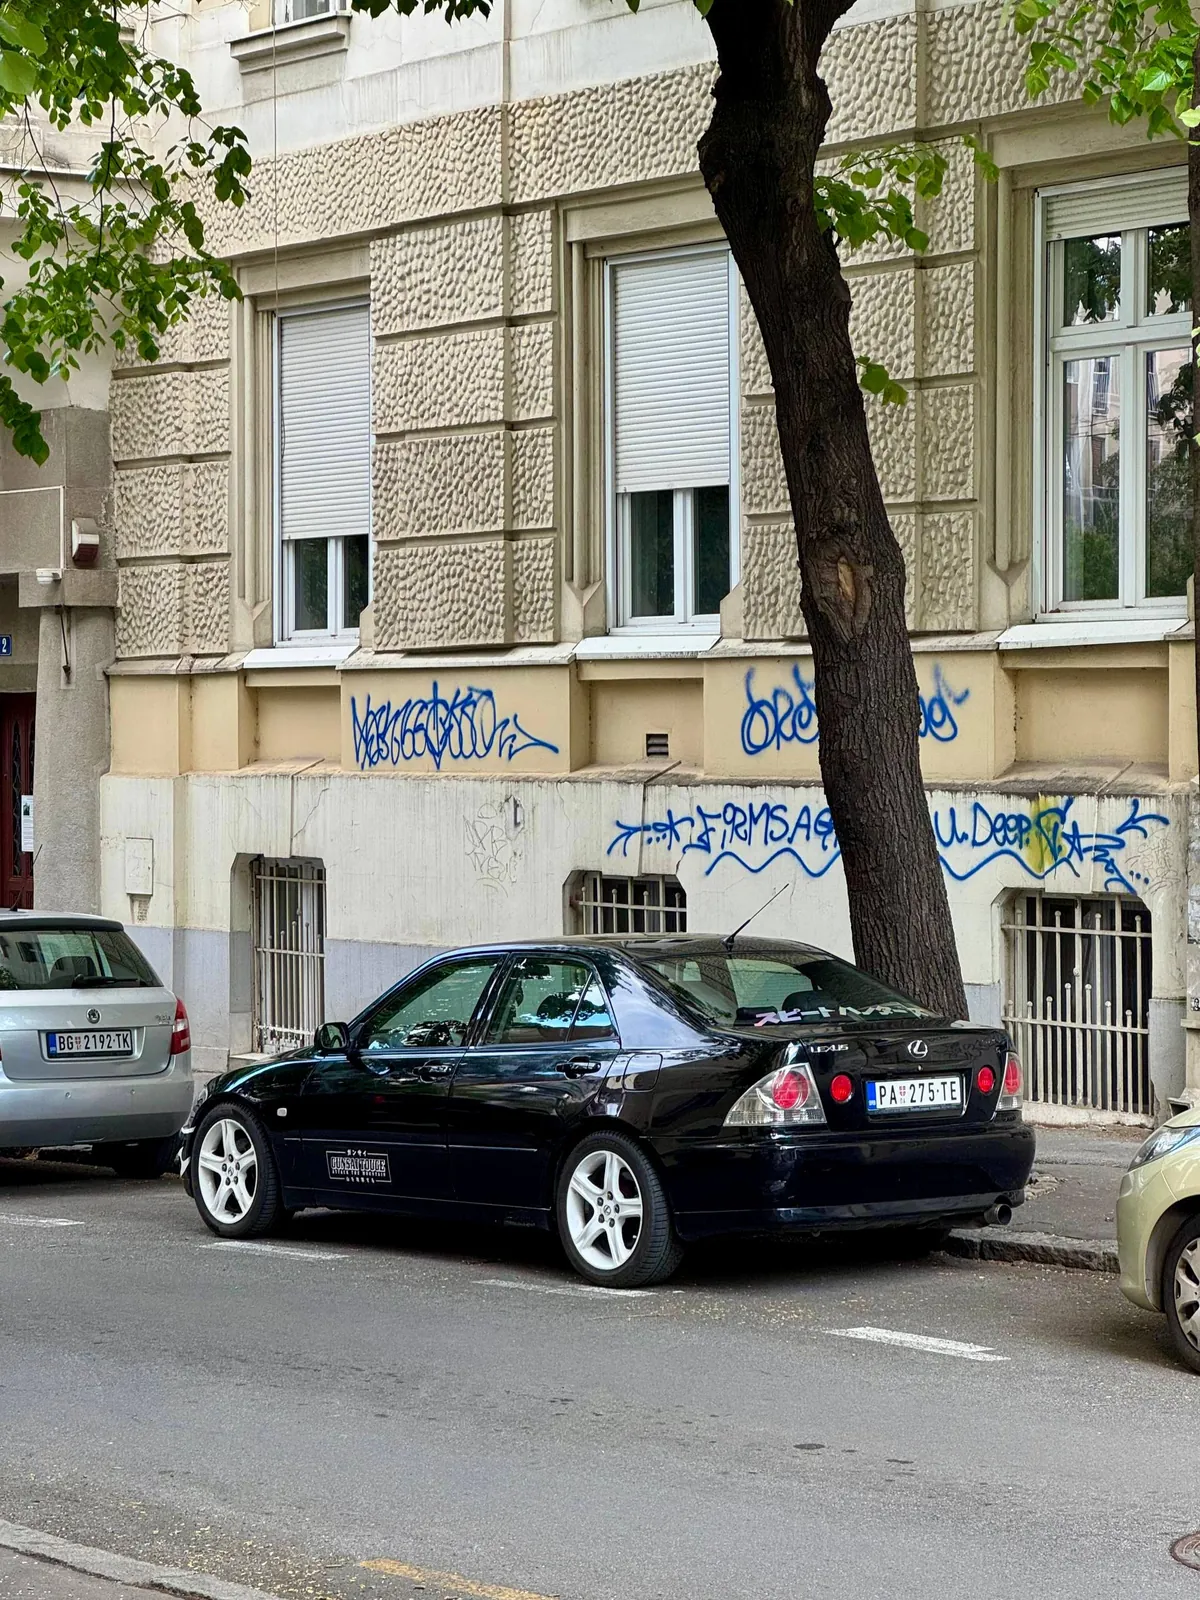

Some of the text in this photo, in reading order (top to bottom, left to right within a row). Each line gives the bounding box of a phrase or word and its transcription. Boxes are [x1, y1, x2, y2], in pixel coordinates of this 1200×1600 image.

[58, 1035, 74, 1051] BG
[810, 1044, 849, 1053] LEXUS
[879, 1085, 898, 1105] PA
